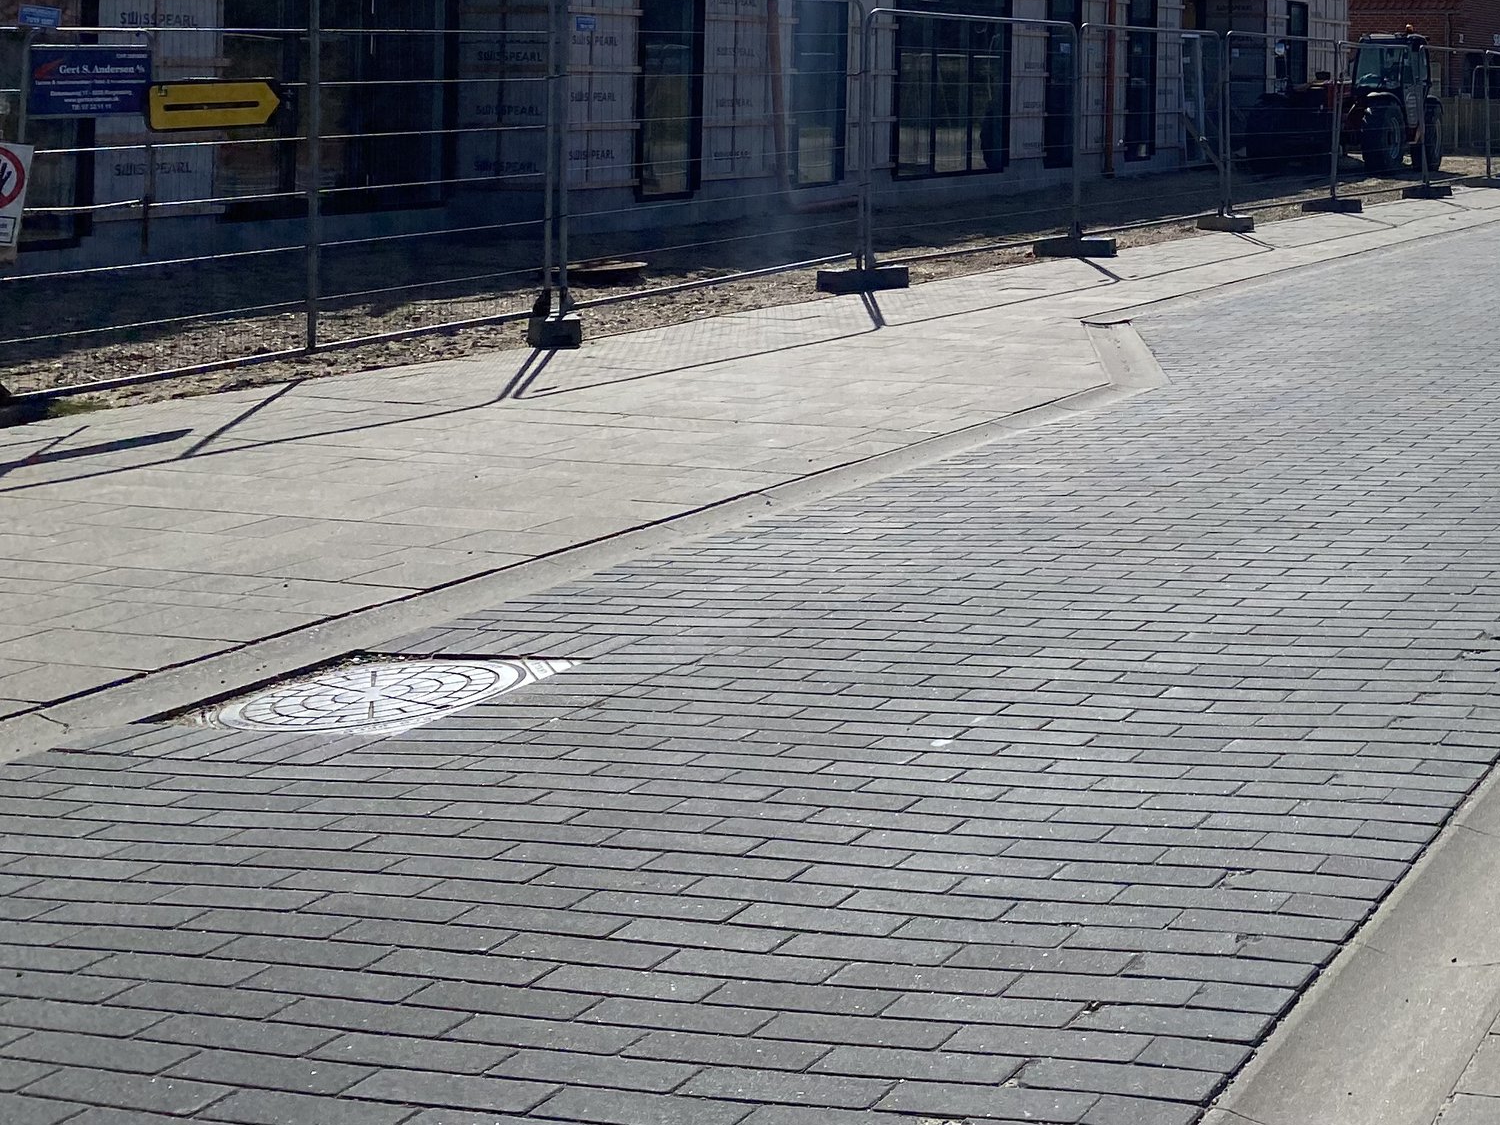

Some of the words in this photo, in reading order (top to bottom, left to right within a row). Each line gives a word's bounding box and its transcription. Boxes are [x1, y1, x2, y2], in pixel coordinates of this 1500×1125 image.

[572, 35, 619, 46] SWISPEARL
[59, 65, 80, 74] Gert
[93, 64, 134, 74] Andersen
[570, 91, 617, 102] SWISPEARL
[568, 149, 615, 161] SWISPEARL
[114, 162, 192, 176] SWISPEARL
